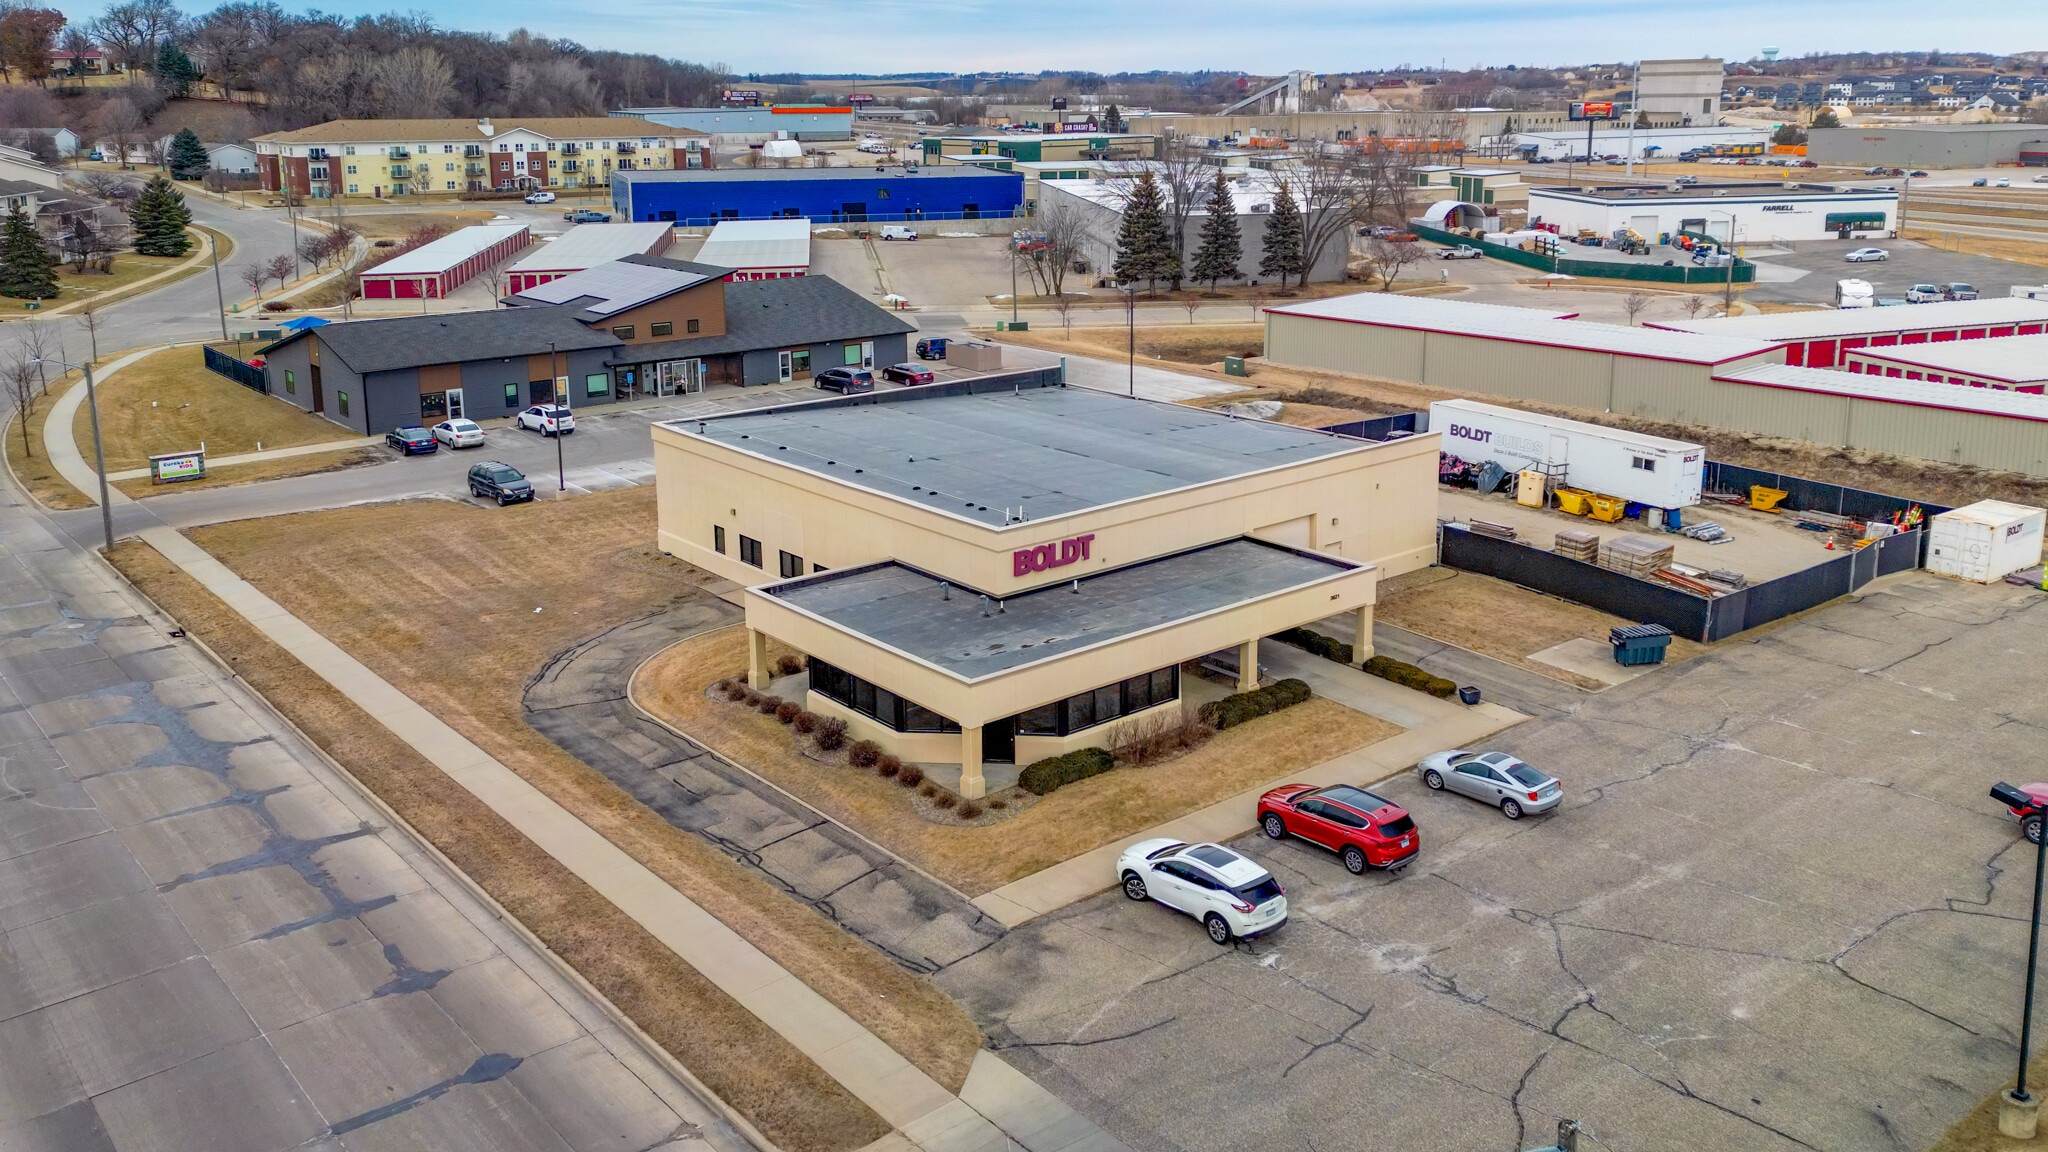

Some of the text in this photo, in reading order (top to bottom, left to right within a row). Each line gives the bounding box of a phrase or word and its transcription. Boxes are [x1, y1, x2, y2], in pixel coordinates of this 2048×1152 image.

[1450, 424, 1543, 455] BOLDT BUILDS
[1683, 455, 1699, 463] BOLDT
[2007, 523, 2024, 537] BOLDT
[1013, 534, 1095, 577] BOLDT
